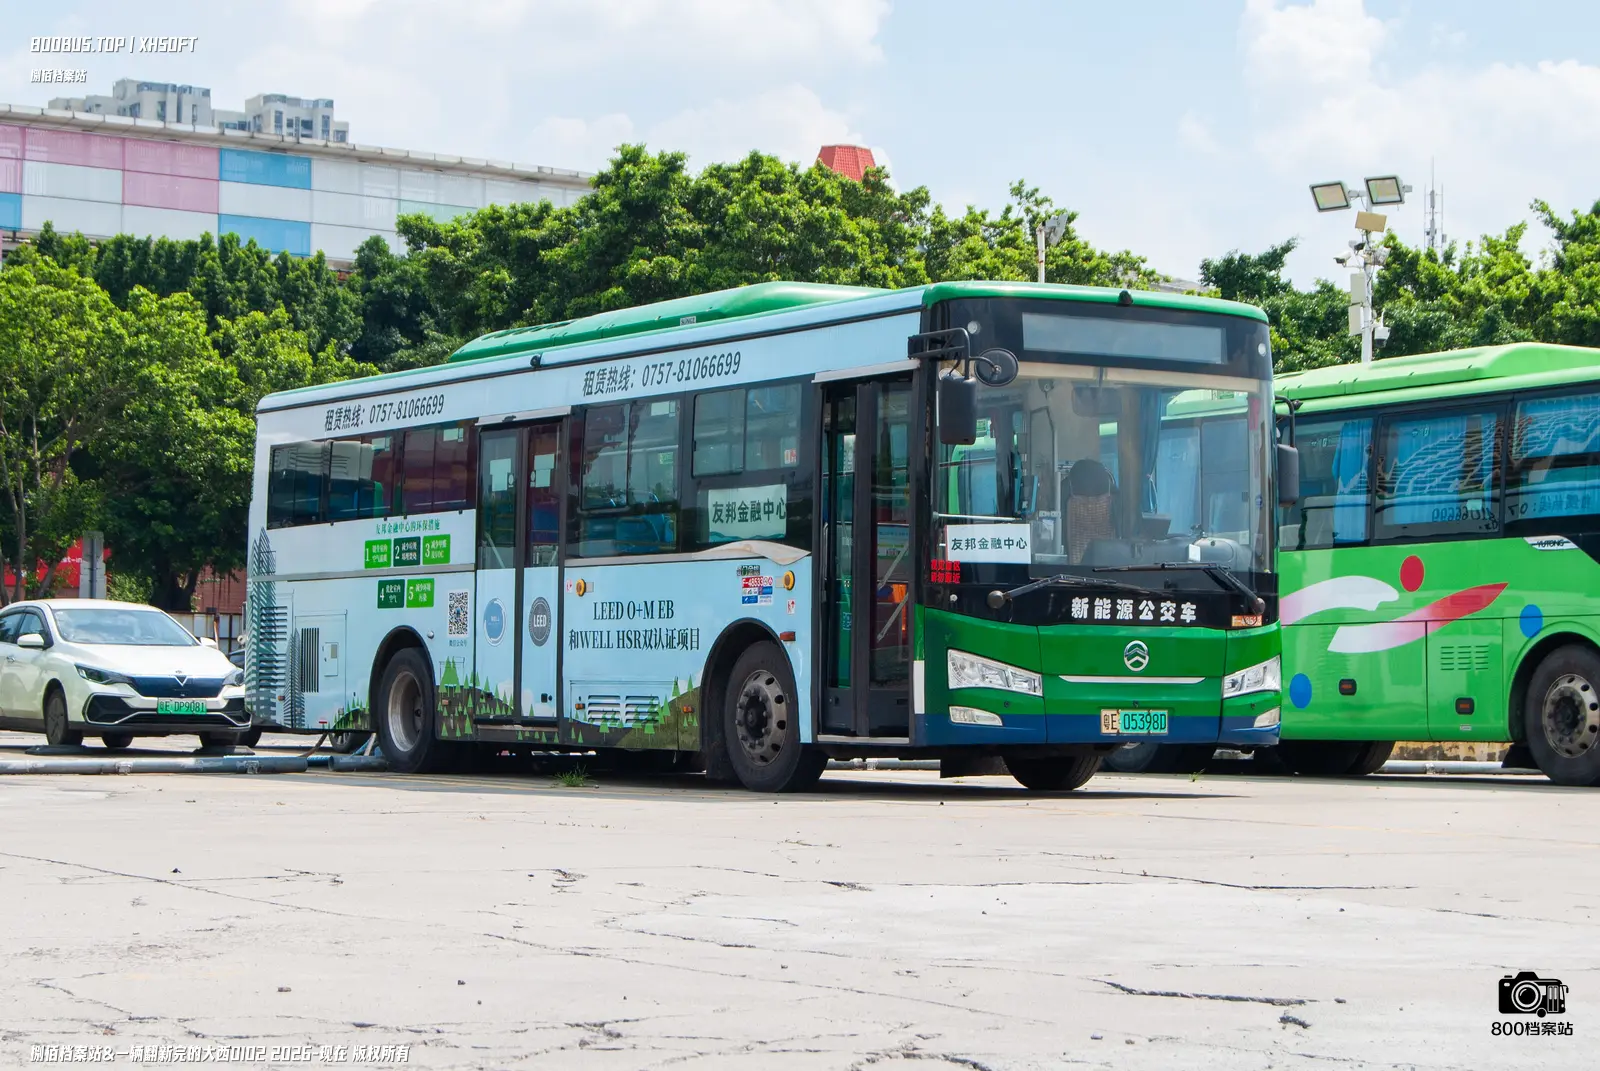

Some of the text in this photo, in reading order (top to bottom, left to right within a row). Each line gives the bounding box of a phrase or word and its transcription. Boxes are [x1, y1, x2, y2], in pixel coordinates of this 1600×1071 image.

[712, 497, 787, 524] 友邦金融中心
[425, 543, 430, 558] 3
[951, 537, 1028, 551] 友邦金融中心
[366, 548, 370, 562] 1
[394, 545, 400, 560] 2
[380, 588, 385, 601] 4
[408, 586, 414, 600] 5
[593, 599, 674, 620] LEED O+M EB
[1071, 597, 1197, 623] 新能源公交车
[533, 614, 547, 628] LEED
[1123, 713, 1167, 731] 05398D
